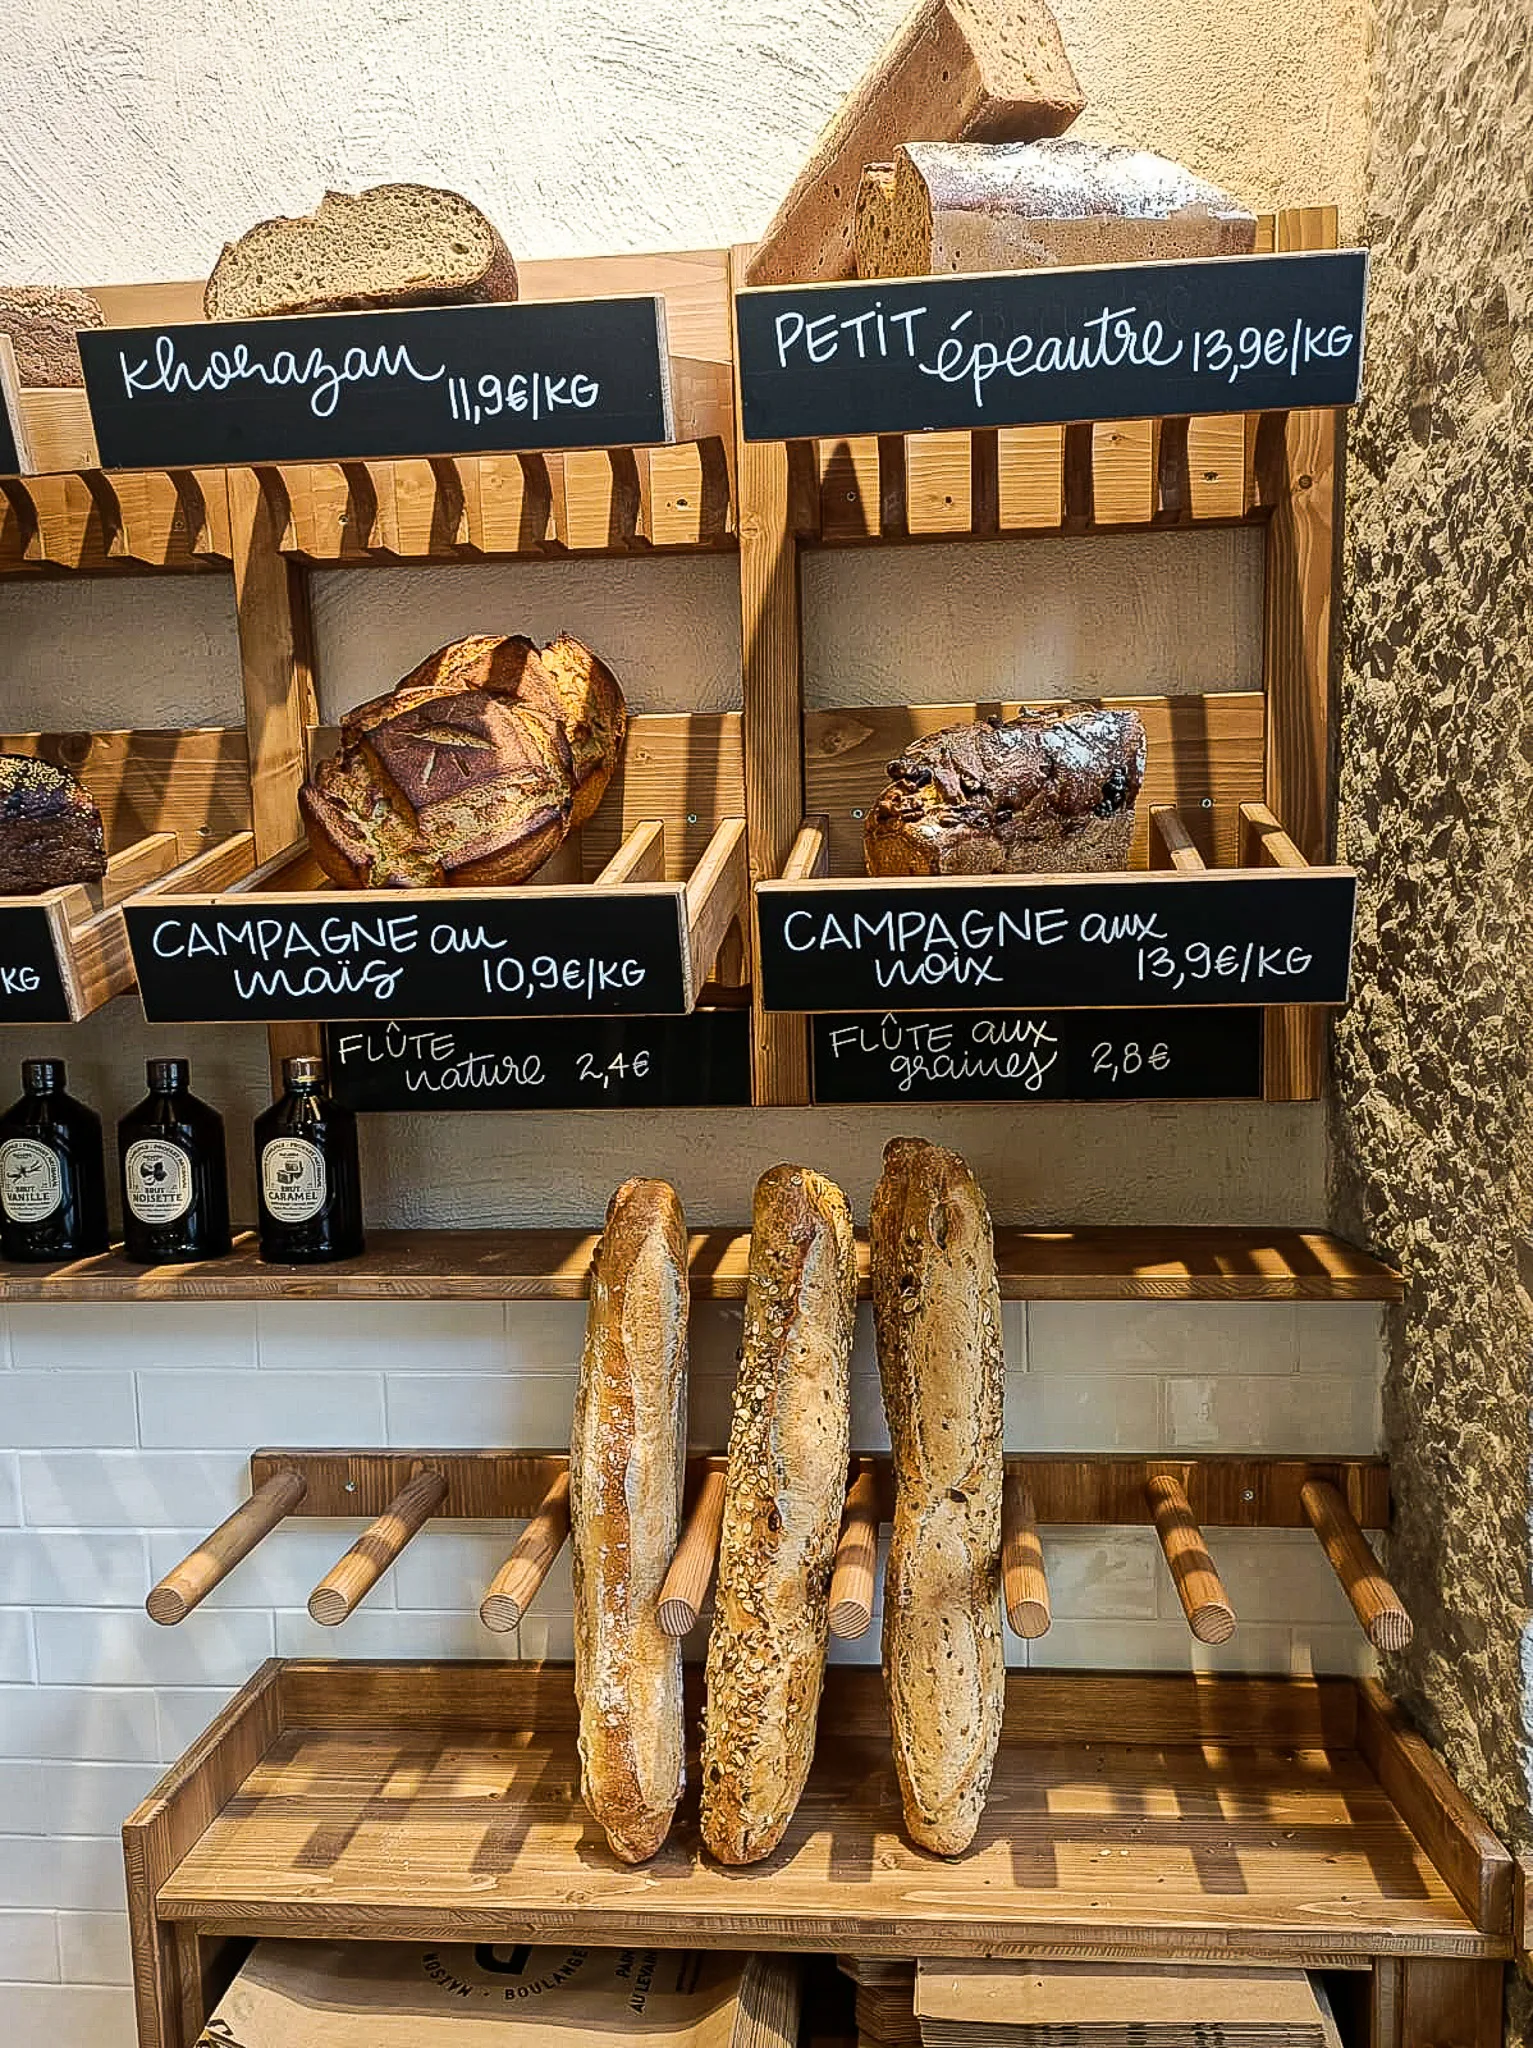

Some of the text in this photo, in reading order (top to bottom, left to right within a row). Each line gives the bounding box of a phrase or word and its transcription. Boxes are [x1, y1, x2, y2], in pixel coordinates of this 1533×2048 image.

[774, 302, 1354, 408] PETIT épeautre 13,9€/KG
[448, 372, 600, 425] 11,9€/KG
[152, 914, 508, 959] CAMPAGNE au
[783, 908, 1168, 952] CAMPAGNE aux
[233, 959, 404, 1000] maïs
[483, 956, 646, 1001] 10,9€/KG
[874, 951, 1004, 988] noix
[1138, 942, 1313, 990] 13,9€/KG
[338, 1022, 455, 1065] FLÛTE
[829, 1012, 1058, 1059] FLÛTE aux
[403, 1051, 546, 1091] nature
[576, 1050, 650, 1089] 2,4€
[889, 1047, 1058, 1092] graines
[1091, 1042, 1171, 1082] 2,8€
[6, 1192, 51, 1202] VANILLE
[132, 1193, 183, 1203] NOISETTE
[268, 1191, 318, 1202] CARAMEL
[628, 1994, 646, 2014] AU
